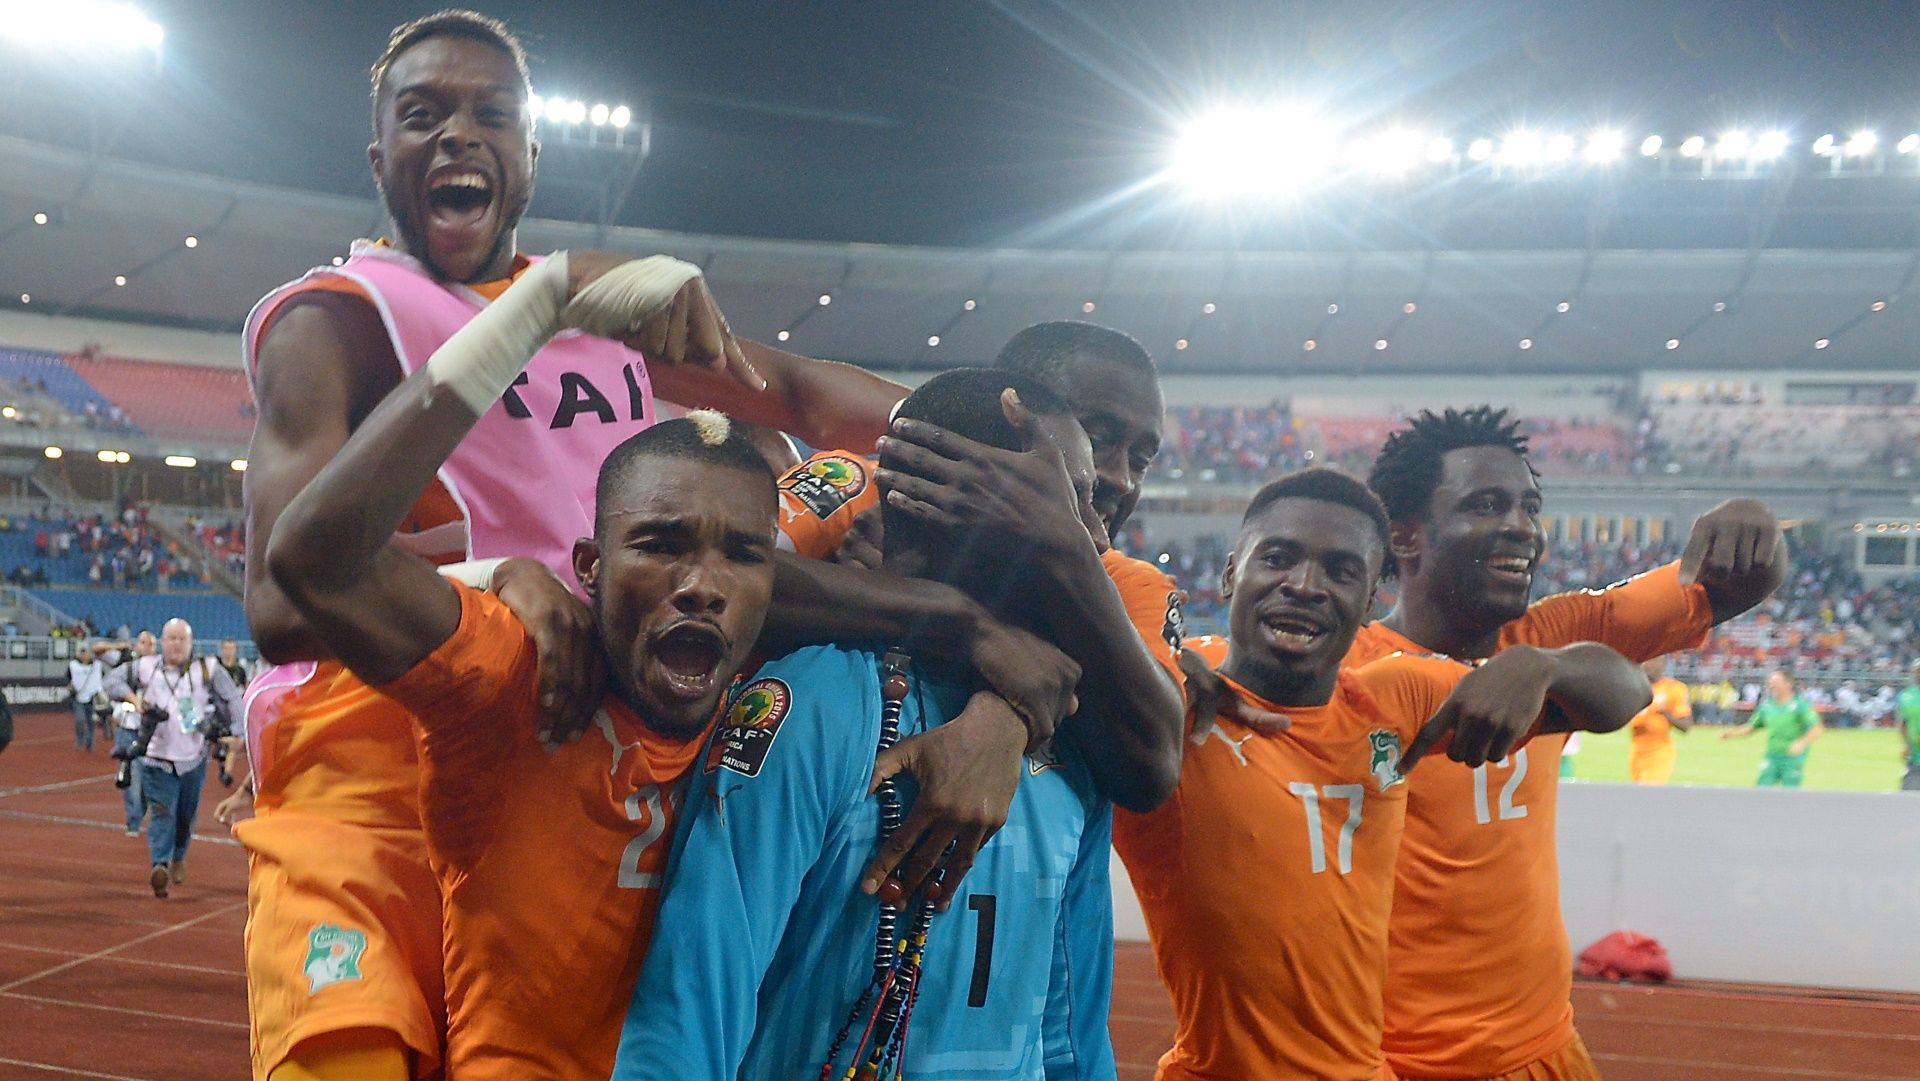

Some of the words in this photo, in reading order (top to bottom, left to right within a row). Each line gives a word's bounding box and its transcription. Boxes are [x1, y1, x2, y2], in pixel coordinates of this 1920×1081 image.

[796, 473, 837, 494] CAF
[768, 700, 784, 720] 2015
[722, 754, 751, 771] NATIONS
[728, 740, 744, 751] RICA
[1473, 747, 1529, 824] 12
[618, 784, 678, 888] 2
[1289, 781, 1365, 874] 17
[968, 894, 997, 1008] 1
